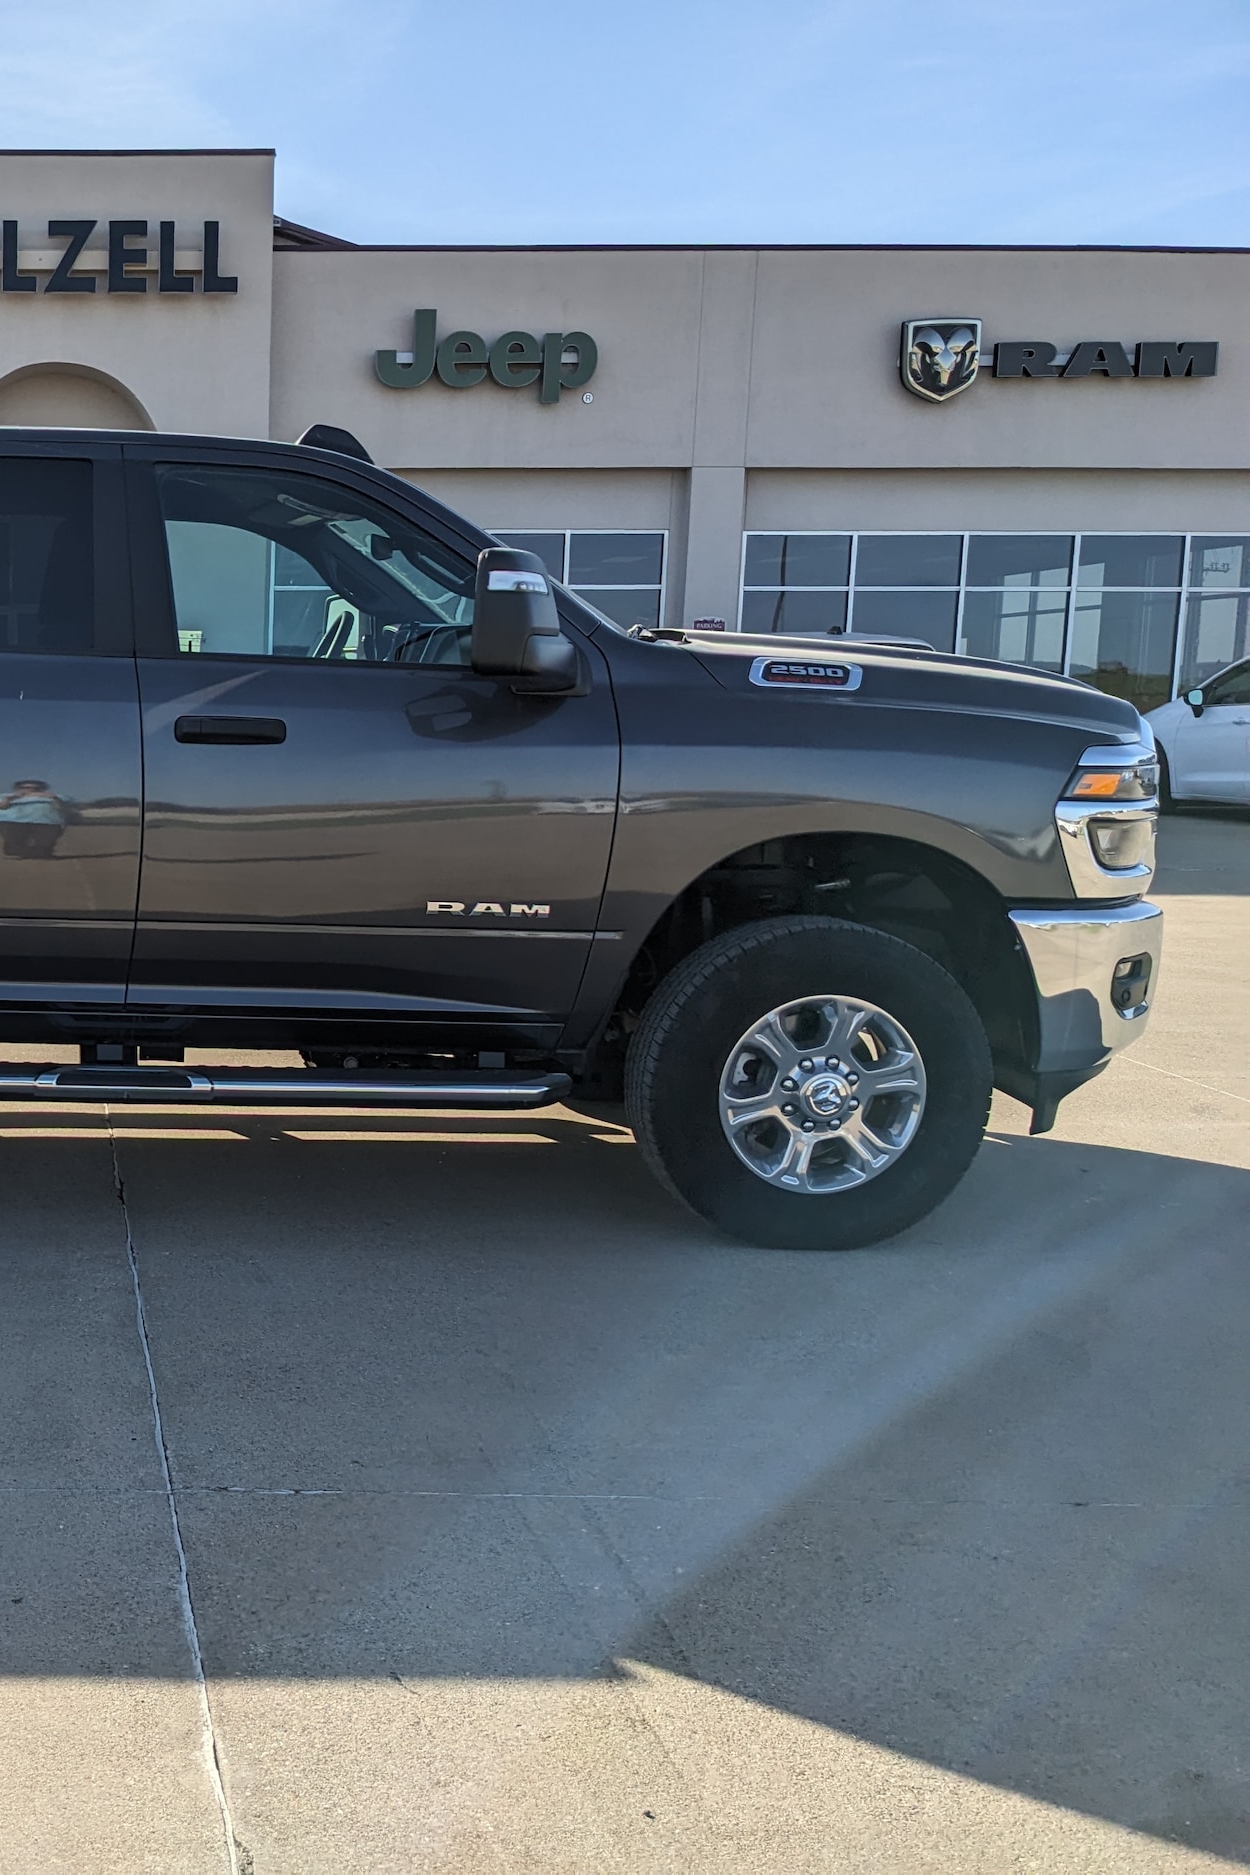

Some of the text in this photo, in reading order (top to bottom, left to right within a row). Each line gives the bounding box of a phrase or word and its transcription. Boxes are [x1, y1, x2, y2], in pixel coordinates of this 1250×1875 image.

[375, 308, 598, 403] Jeep
[993, 341, 1219, 377] RAM
[770, 665, 844, 677] 2500
[425, 900, 550, 919] RAM
